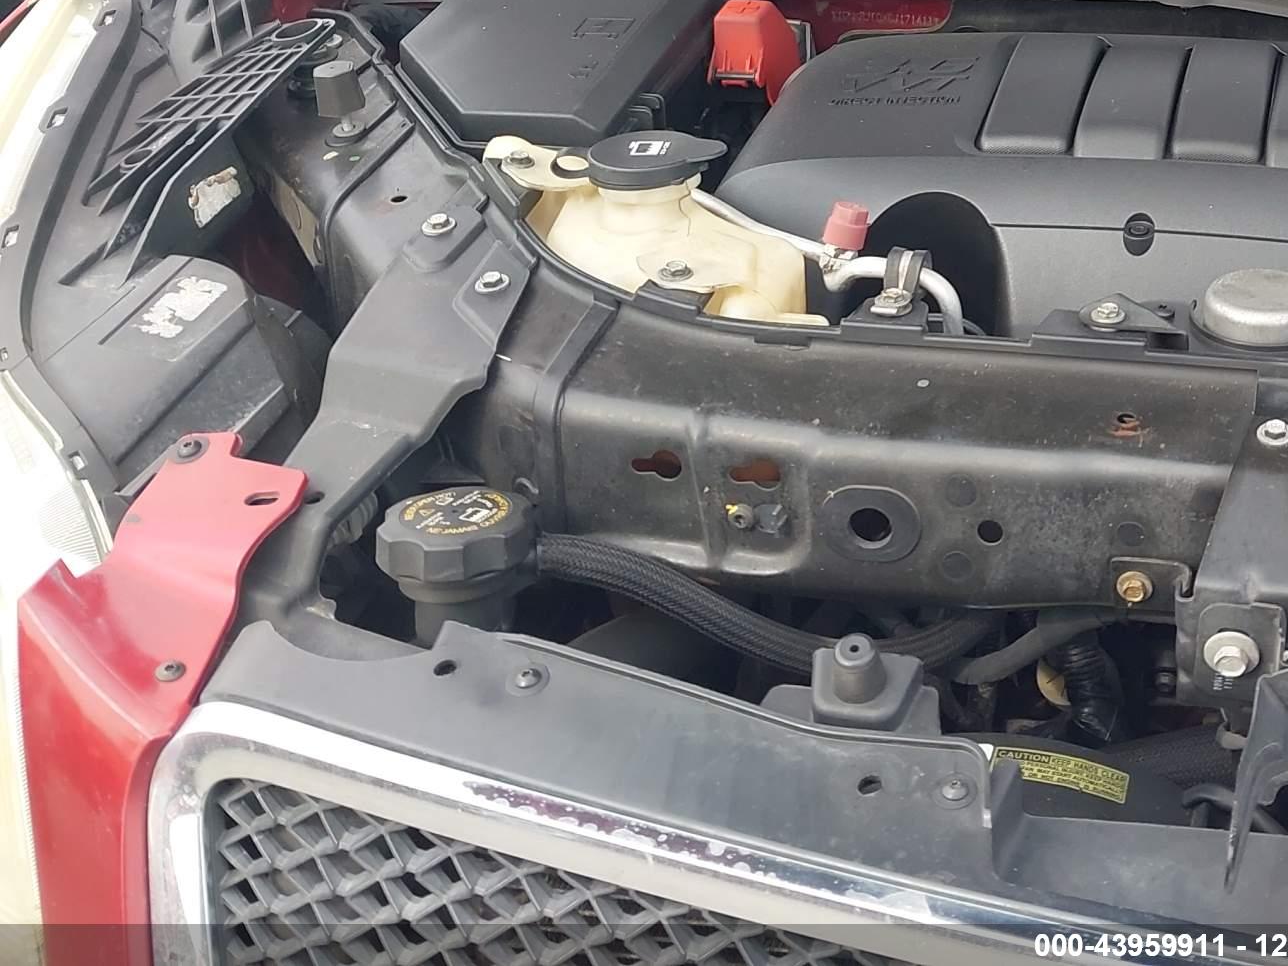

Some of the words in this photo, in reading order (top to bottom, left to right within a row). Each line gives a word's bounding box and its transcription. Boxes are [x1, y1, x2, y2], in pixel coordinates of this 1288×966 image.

[998, 750, 1050, 763] CAUTION
[1073, 760, 1099, 774] HANDS
[1051, 771, 1073, 781] START
